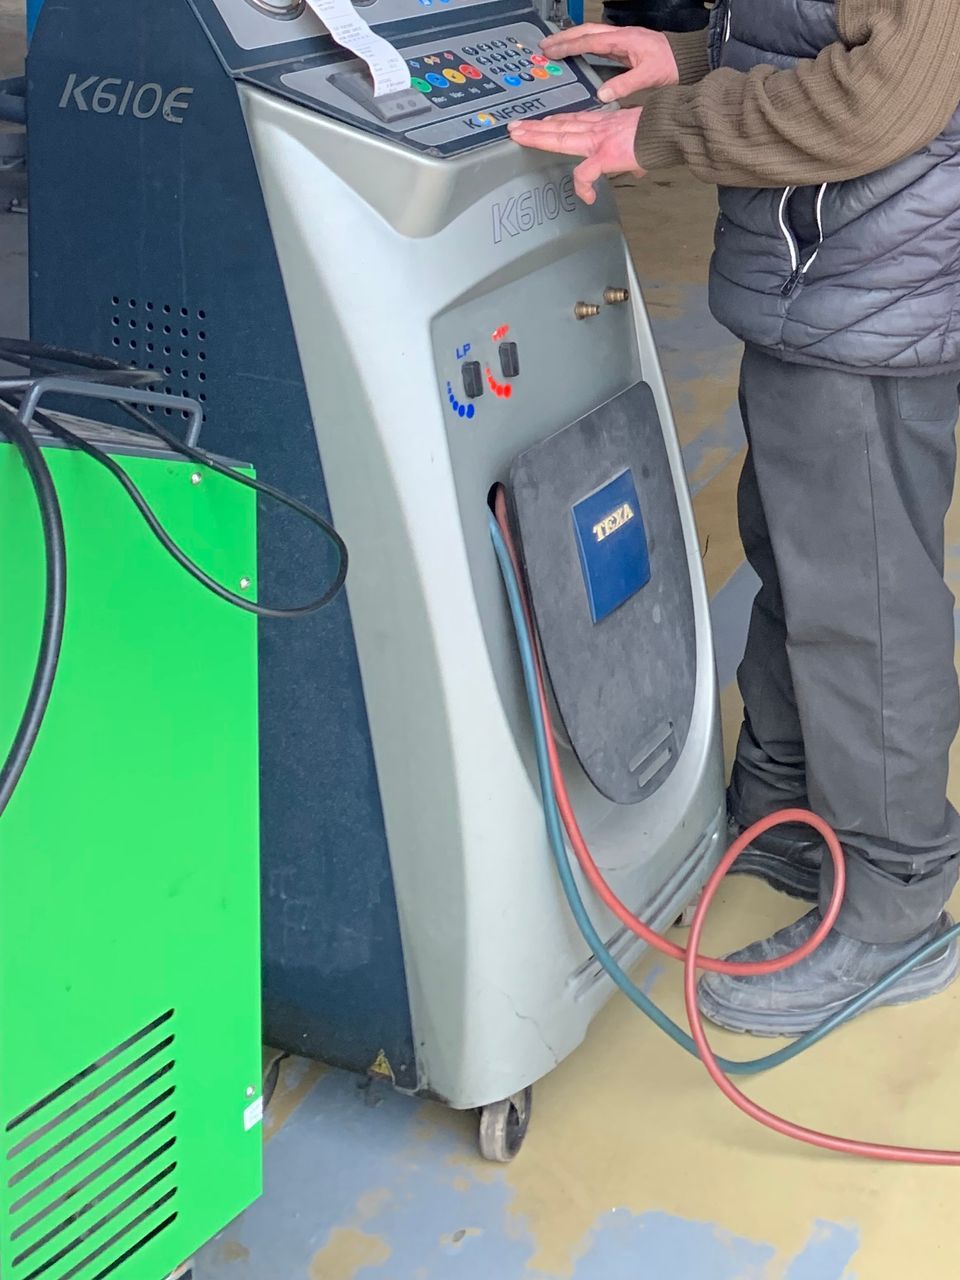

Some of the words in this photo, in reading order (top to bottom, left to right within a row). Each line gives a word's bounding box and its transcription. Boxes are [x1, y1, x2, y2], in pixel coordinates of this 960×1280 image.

[58, 73, 194, 124] K610E
[491, 174, 577, 244] K610E
[456, 343, 471, 359] LP
[592, 503, 635, 543] TEXA
